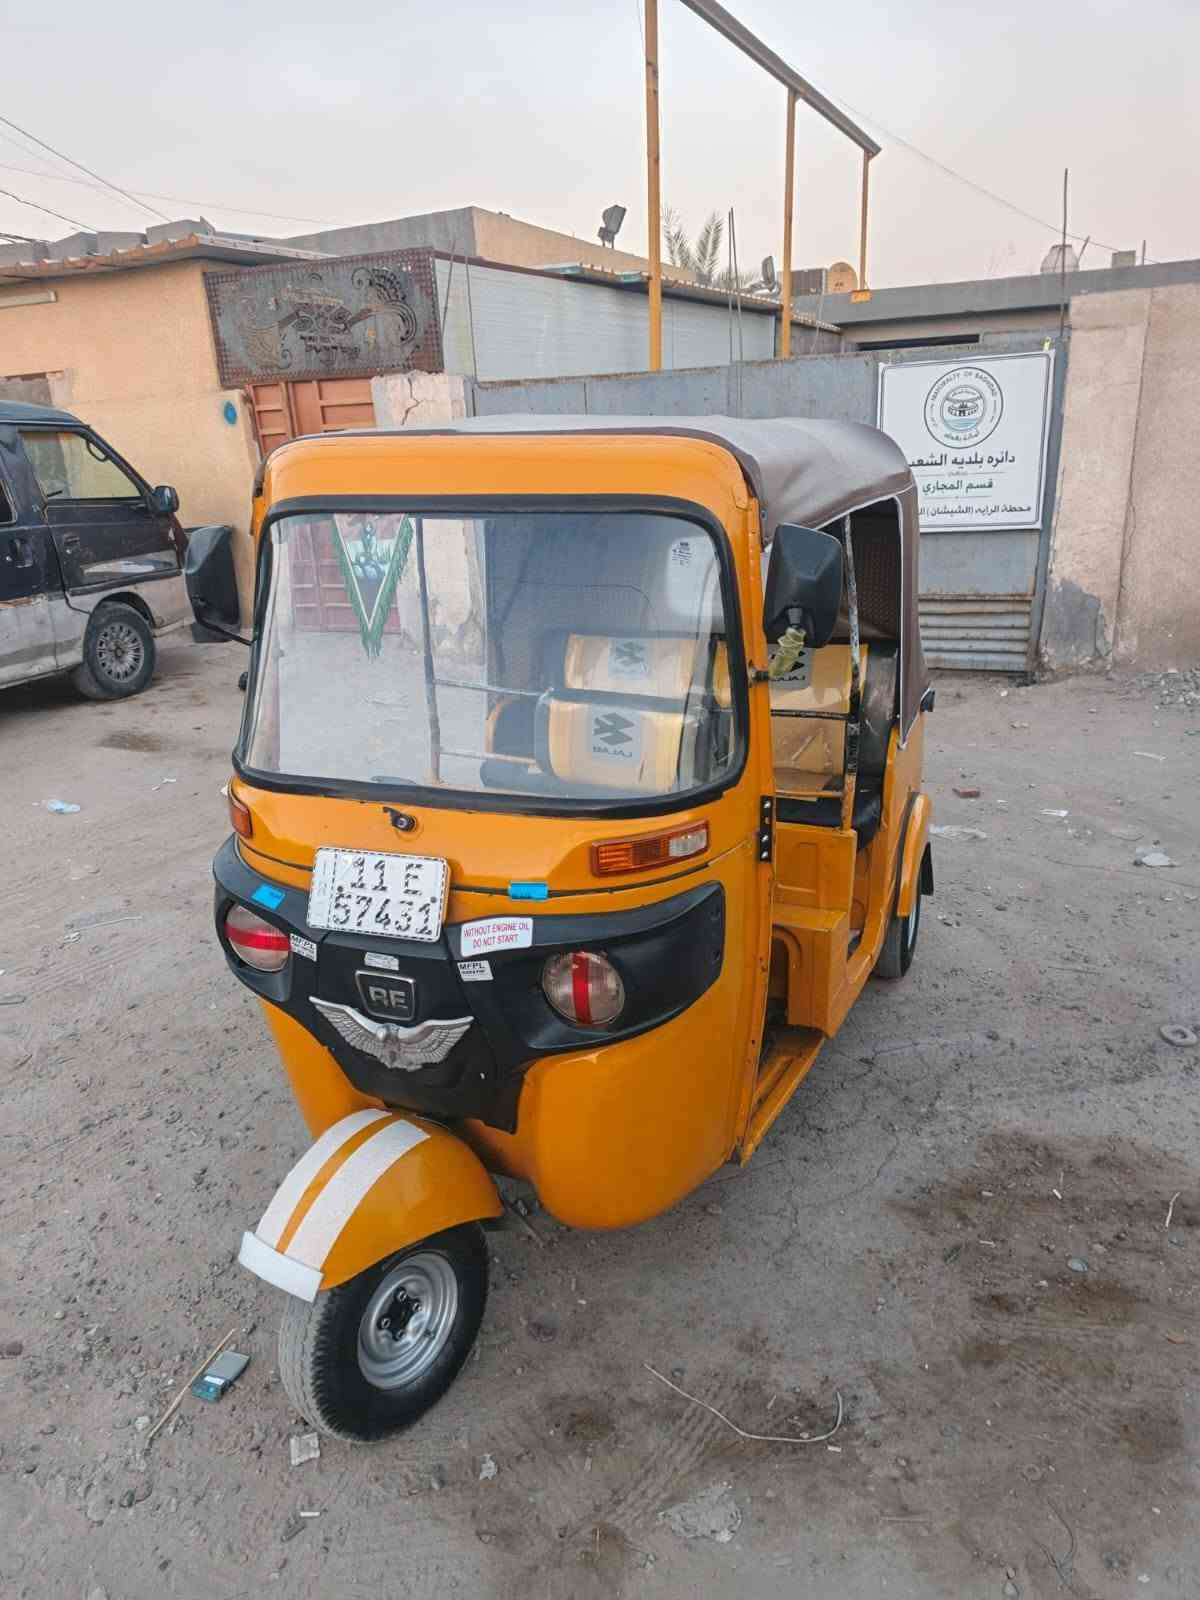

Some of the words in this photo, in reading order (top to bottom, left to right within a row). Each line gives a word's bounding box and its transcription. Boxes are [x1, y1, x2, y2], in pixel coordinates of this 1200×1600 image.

[965, 478, 993, 494] قسم
[463, 925, 491, 938] WITHOUT
[491, 923, 518, 933] ENGINE
[518, 921, 529, 930] OIL
[472, 938, 481, 948] DO
[482, 936, 496, 945] NOT
[496, 934, 519, 944] START
